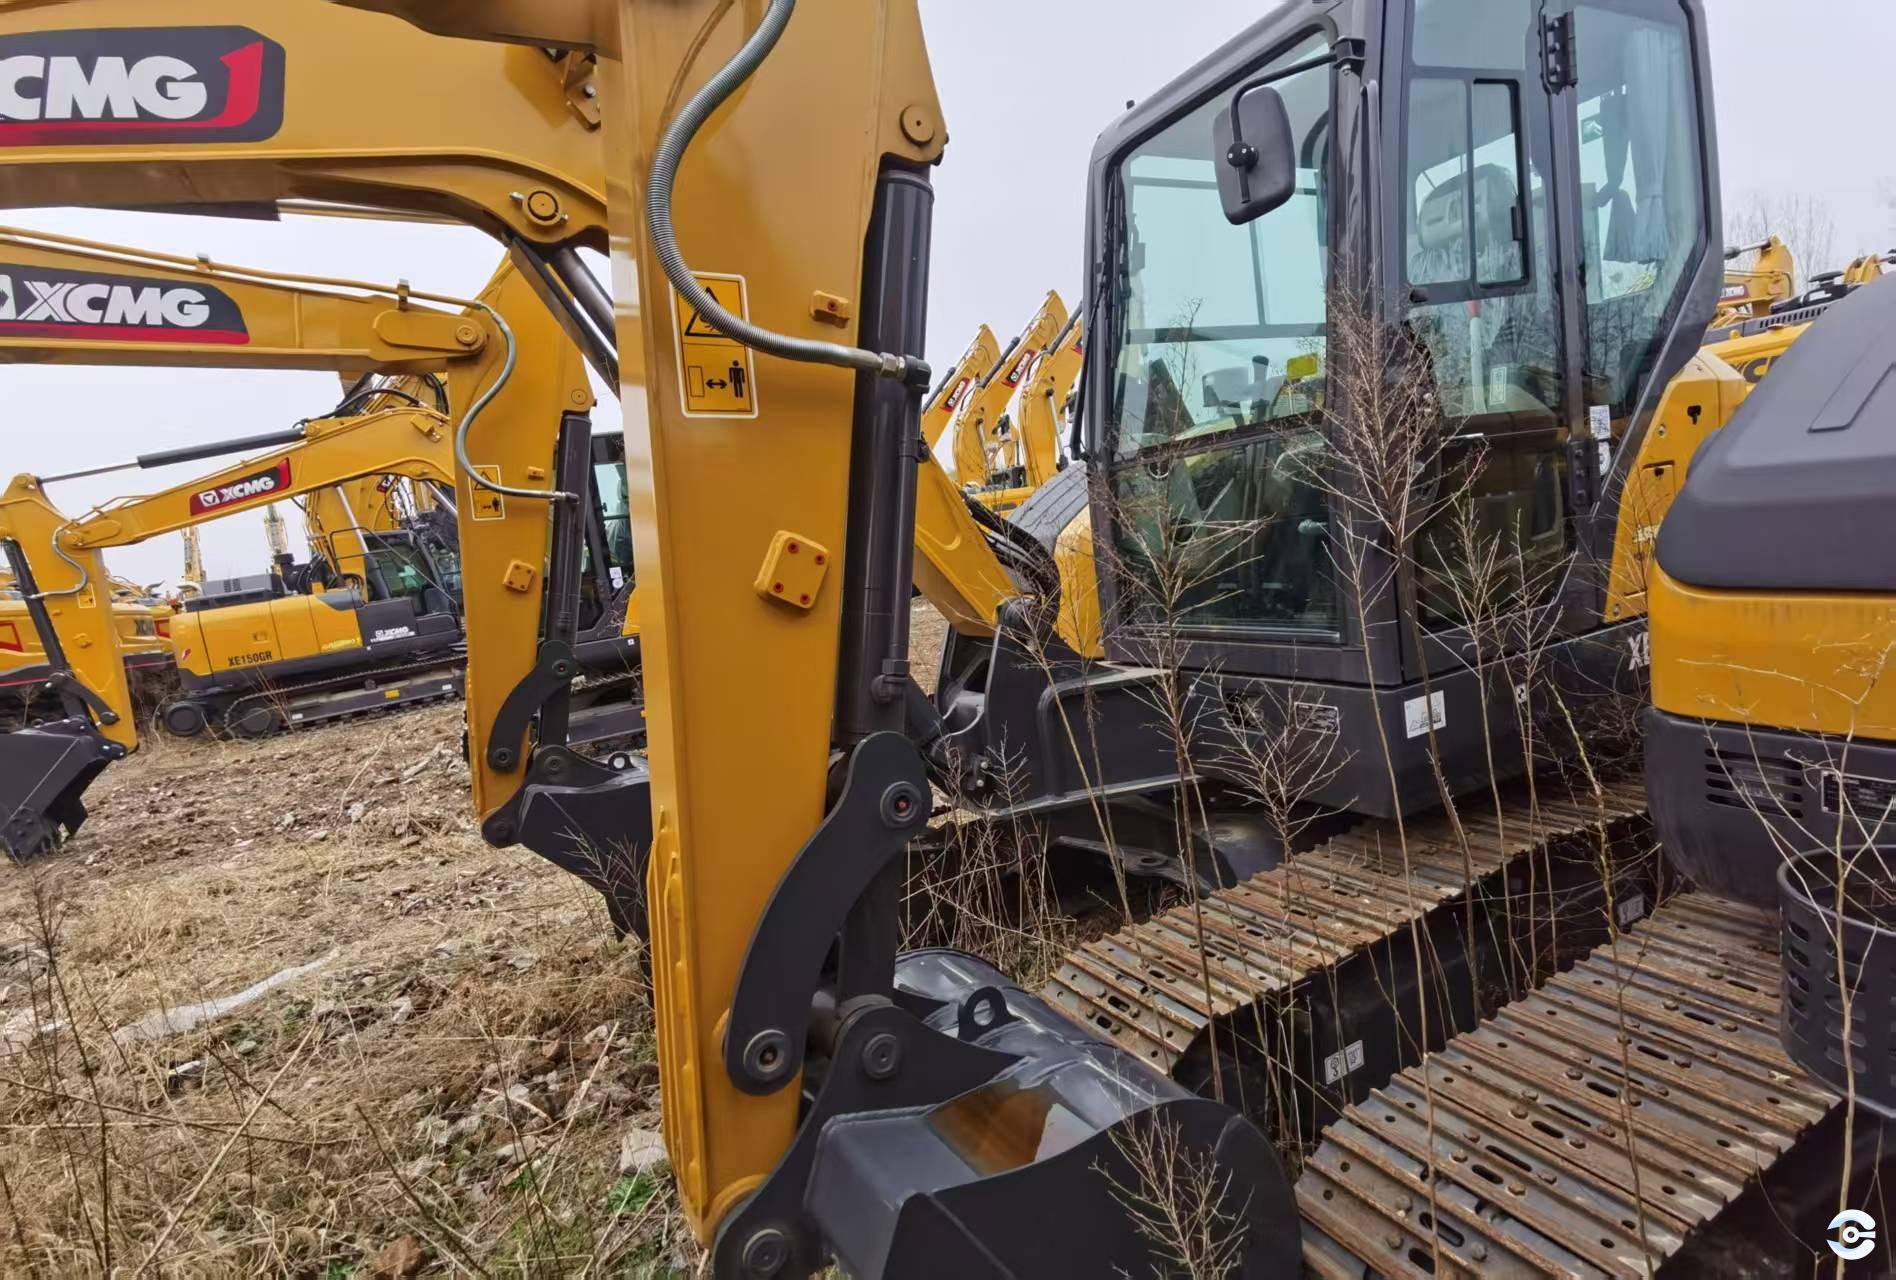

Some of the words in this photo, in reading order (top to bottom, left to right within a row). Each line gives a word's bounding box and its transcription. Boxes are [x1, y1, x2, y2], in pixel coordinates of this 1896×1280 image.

[0, 55, 207, 120] CMG
[17, 280, 209, 327] XCMG
[220, 477, 275, 502] XCMG
